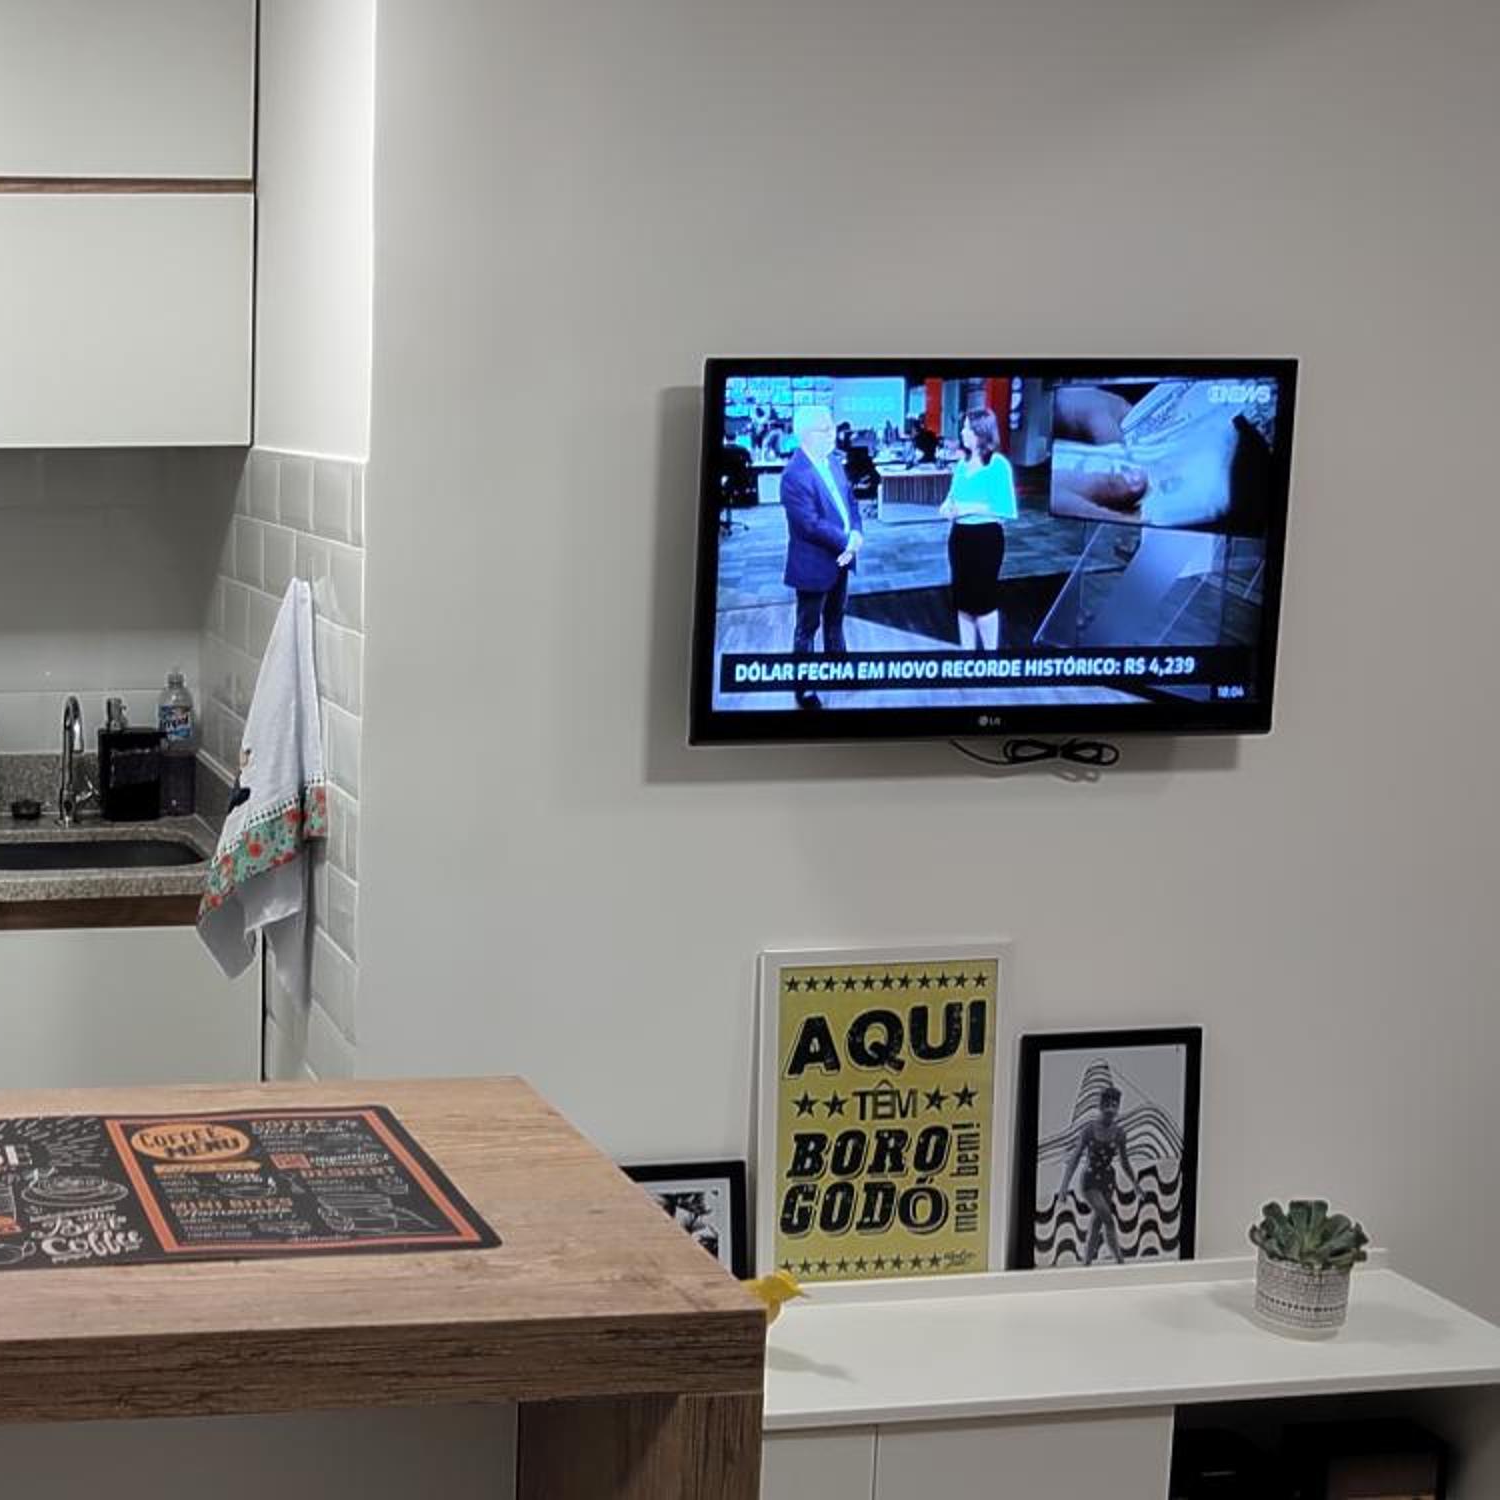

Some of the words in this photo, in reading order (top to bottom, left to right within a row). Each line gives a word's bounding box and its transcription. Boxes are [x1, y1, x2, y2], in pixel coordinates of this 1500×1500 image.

[735, 661, 793, 682] DÓLAR
[797, 662, 854, 681] FECHA
[857, 662, 884, 680] EM
[888, 661, 938, 679] NOVO
[942, 660, 1021, 678] RECORDE
[1025, 657, 1121, 677] HISTÓRICO:
[1124, 657, 1145, 675] R$
[1149, 657, 1195, 677] 4,239
[784, 998, 988, 1079] AQUI
[852, 1080, 918, 1122] TÊM
[139, 1126, 220, 1149] COFFEE
[164, 1137, 240, 1159] MENU
[786, 1124, 952, 1181] BORO
[950, 1121, 983, 1180] bem!
[780, 1176, 949, 1238] GODÓ
[952, 1188, 979, 1234] meu
[41, 1229, 143, 1257] Coffee
